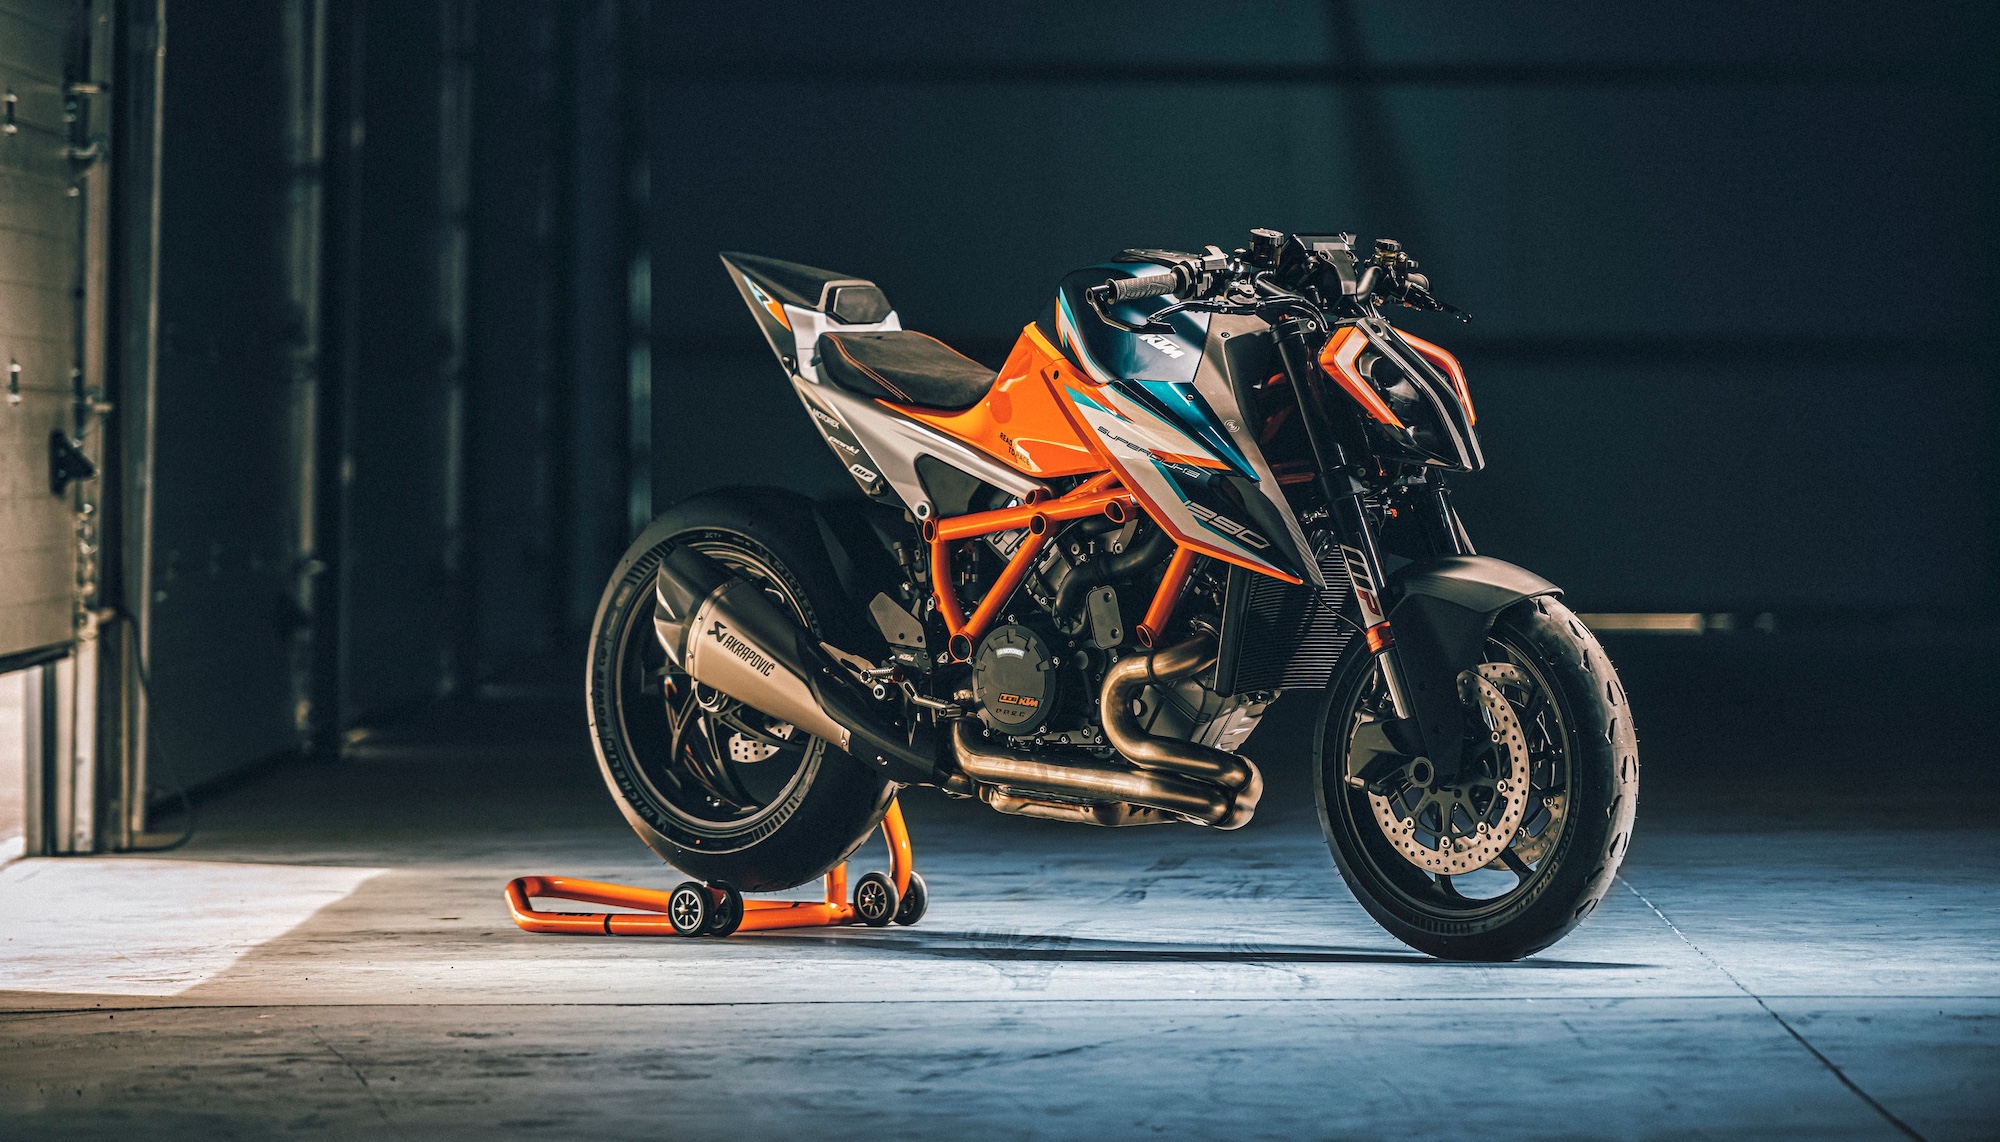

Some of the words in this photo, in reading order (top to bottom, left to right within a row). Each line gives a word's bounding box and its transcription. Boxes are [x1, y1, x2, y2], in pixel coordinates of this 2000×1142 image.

[1138, 333, 1186, 359] KTM
[1000, 431, 1015, 447] READ
[1183, 499, 1272, 550] 1290
